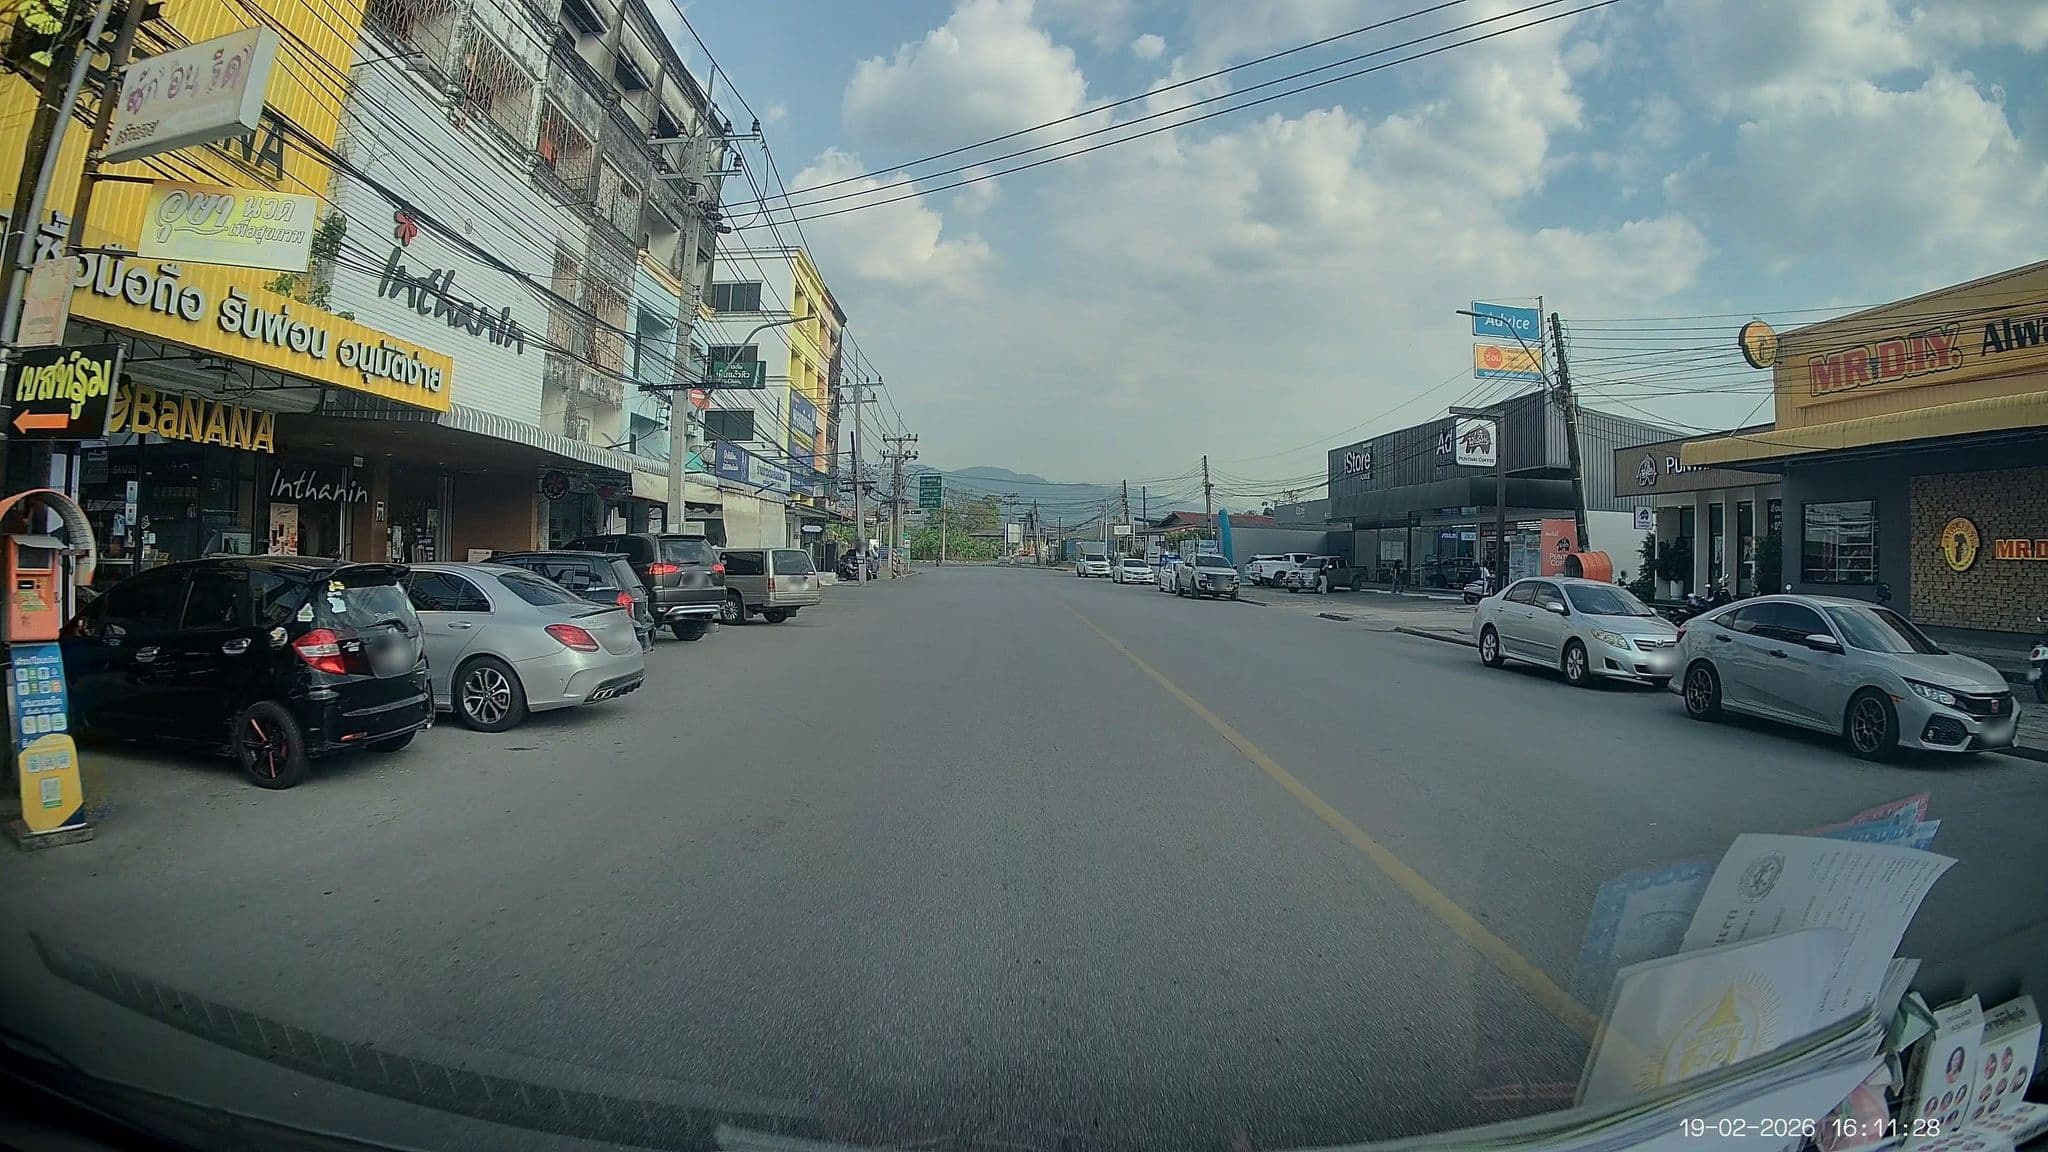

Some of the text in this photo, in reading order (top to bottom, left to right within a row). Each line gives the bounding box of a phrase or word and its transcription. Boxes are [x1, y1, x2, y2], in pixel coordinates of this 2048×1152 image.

[242, 196, 296, 223] นวด
[227, 218, 305, 245] เพื่อสุขภาพ
[378, 246, 525, 355] Inthanin
[1484, 311, 1531, 330] Advice
[131, 383, 275, 454] BaNANA
[270, 467, 368, 504] Inthanin
